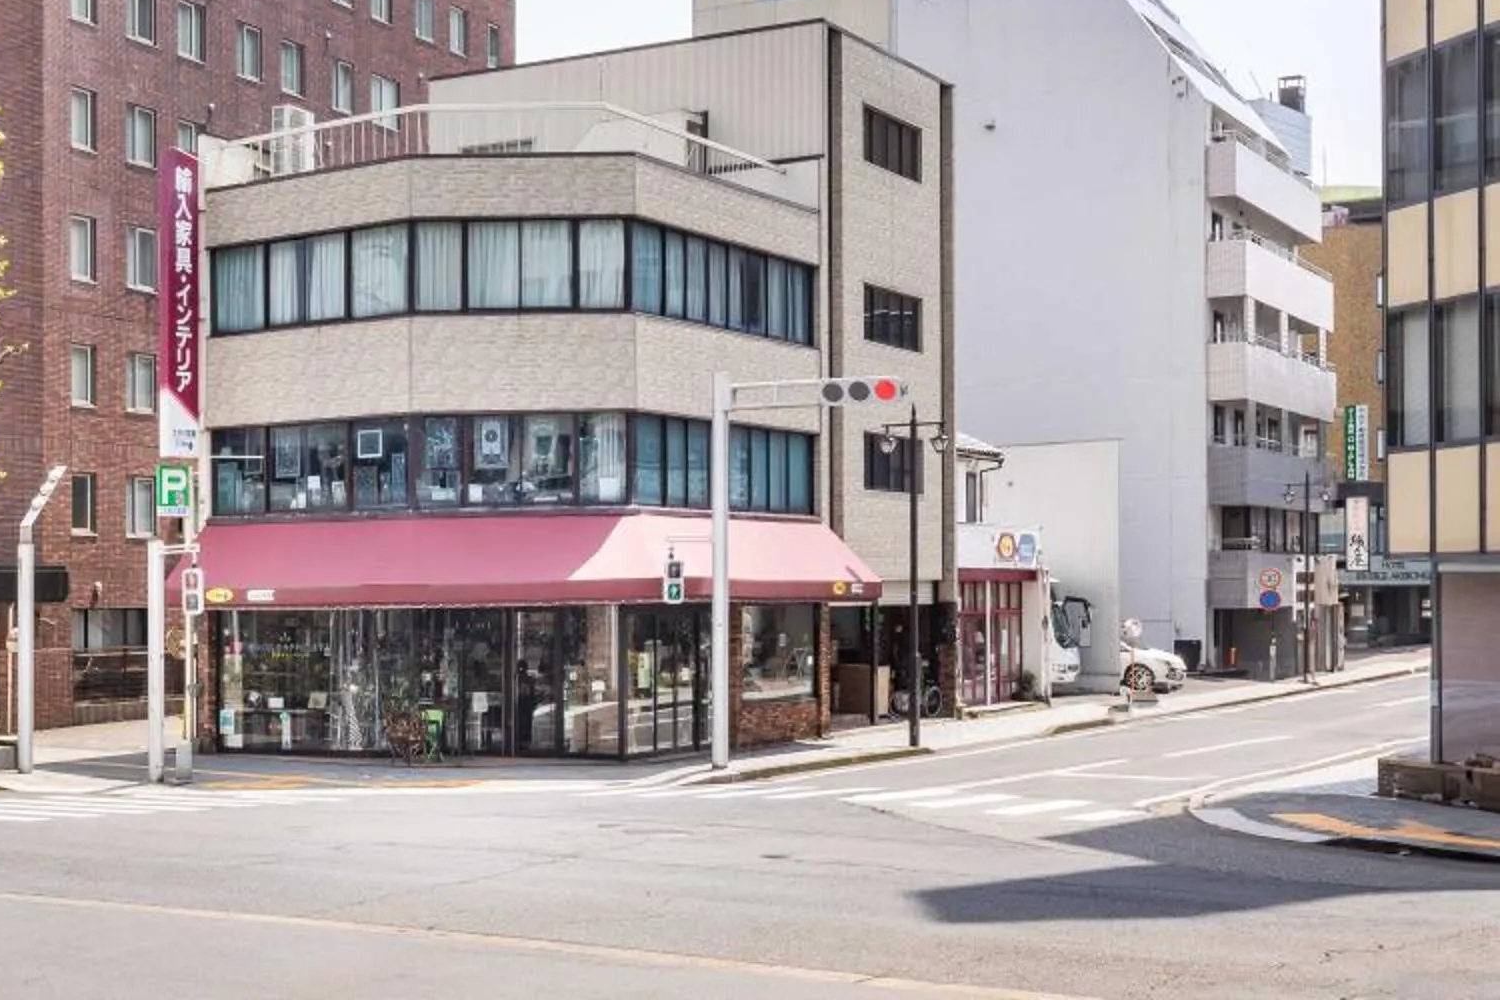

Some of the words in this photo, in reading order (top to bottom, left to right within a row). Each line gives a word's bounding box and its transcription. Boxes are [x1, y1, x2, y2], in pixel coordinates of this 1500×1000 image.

[174, 165, 193, 393] 輸入家具・インテリア
[161, 468, 187, 505] P
